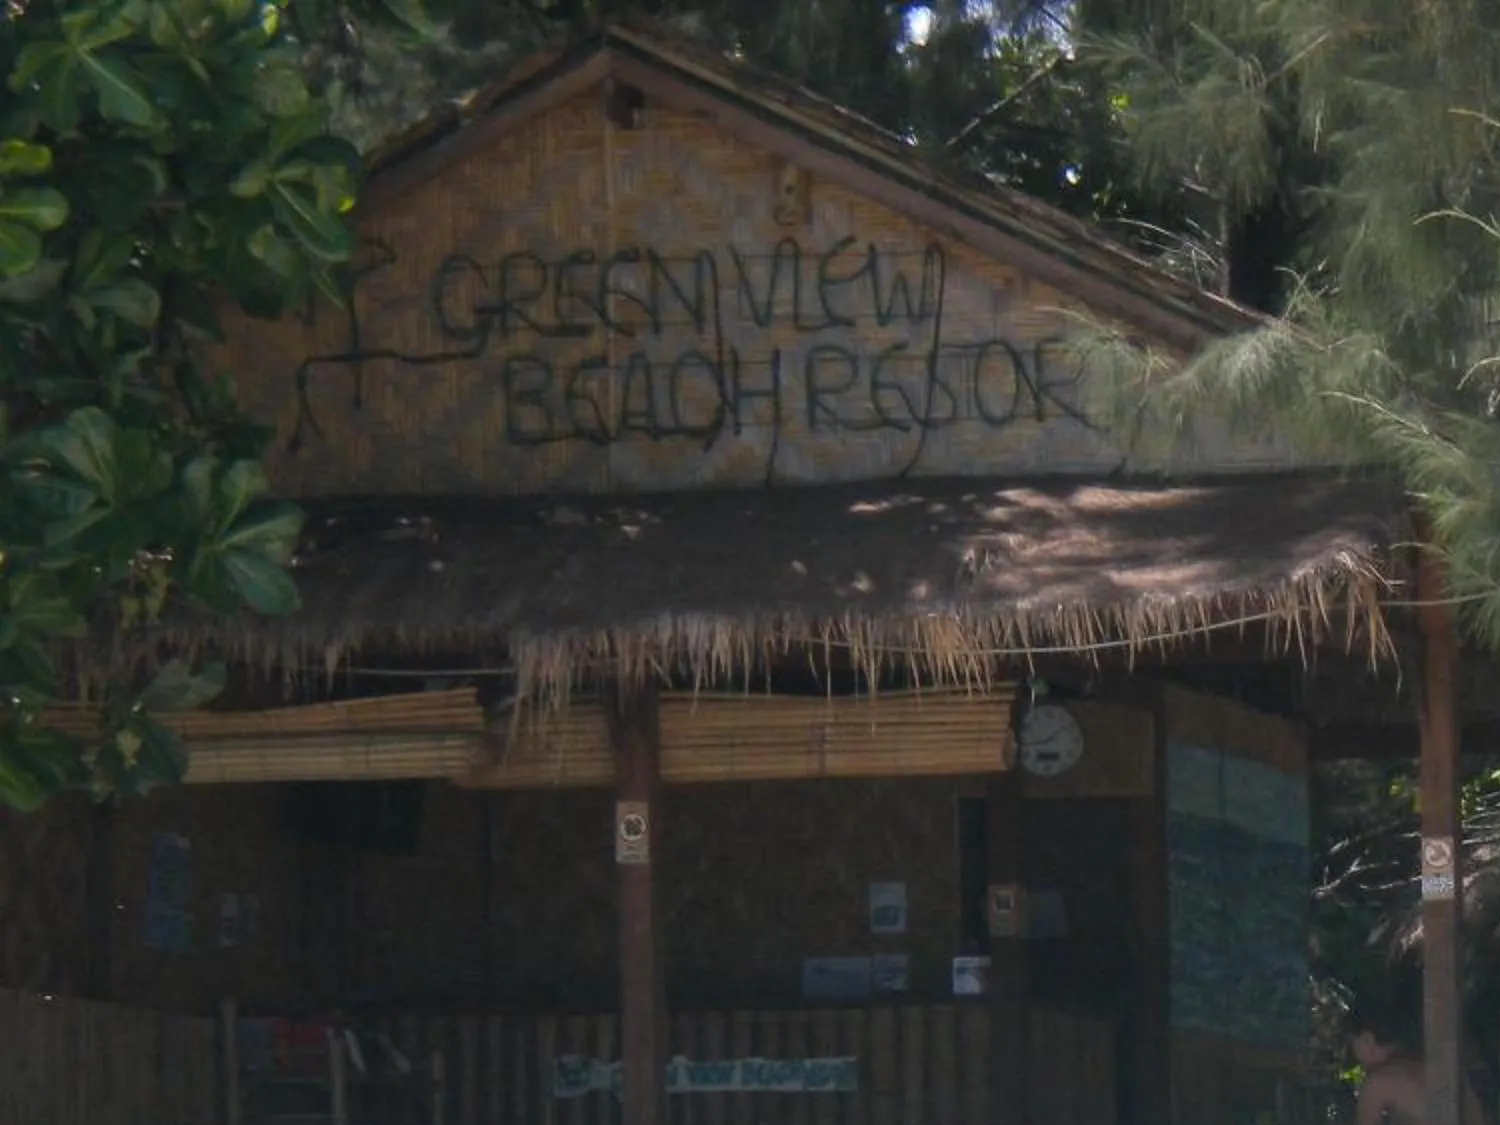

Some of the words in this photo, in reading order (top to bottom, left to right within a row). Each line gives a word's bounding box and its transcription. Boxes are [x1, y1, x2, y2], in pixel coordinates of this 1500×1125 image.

[433, 247, 714, 346] GREEN
[727, 236, 946, 332] VIEW
[505, 346, 784, 448] BEACH
[806, 340, 1130, 432] RESOR
